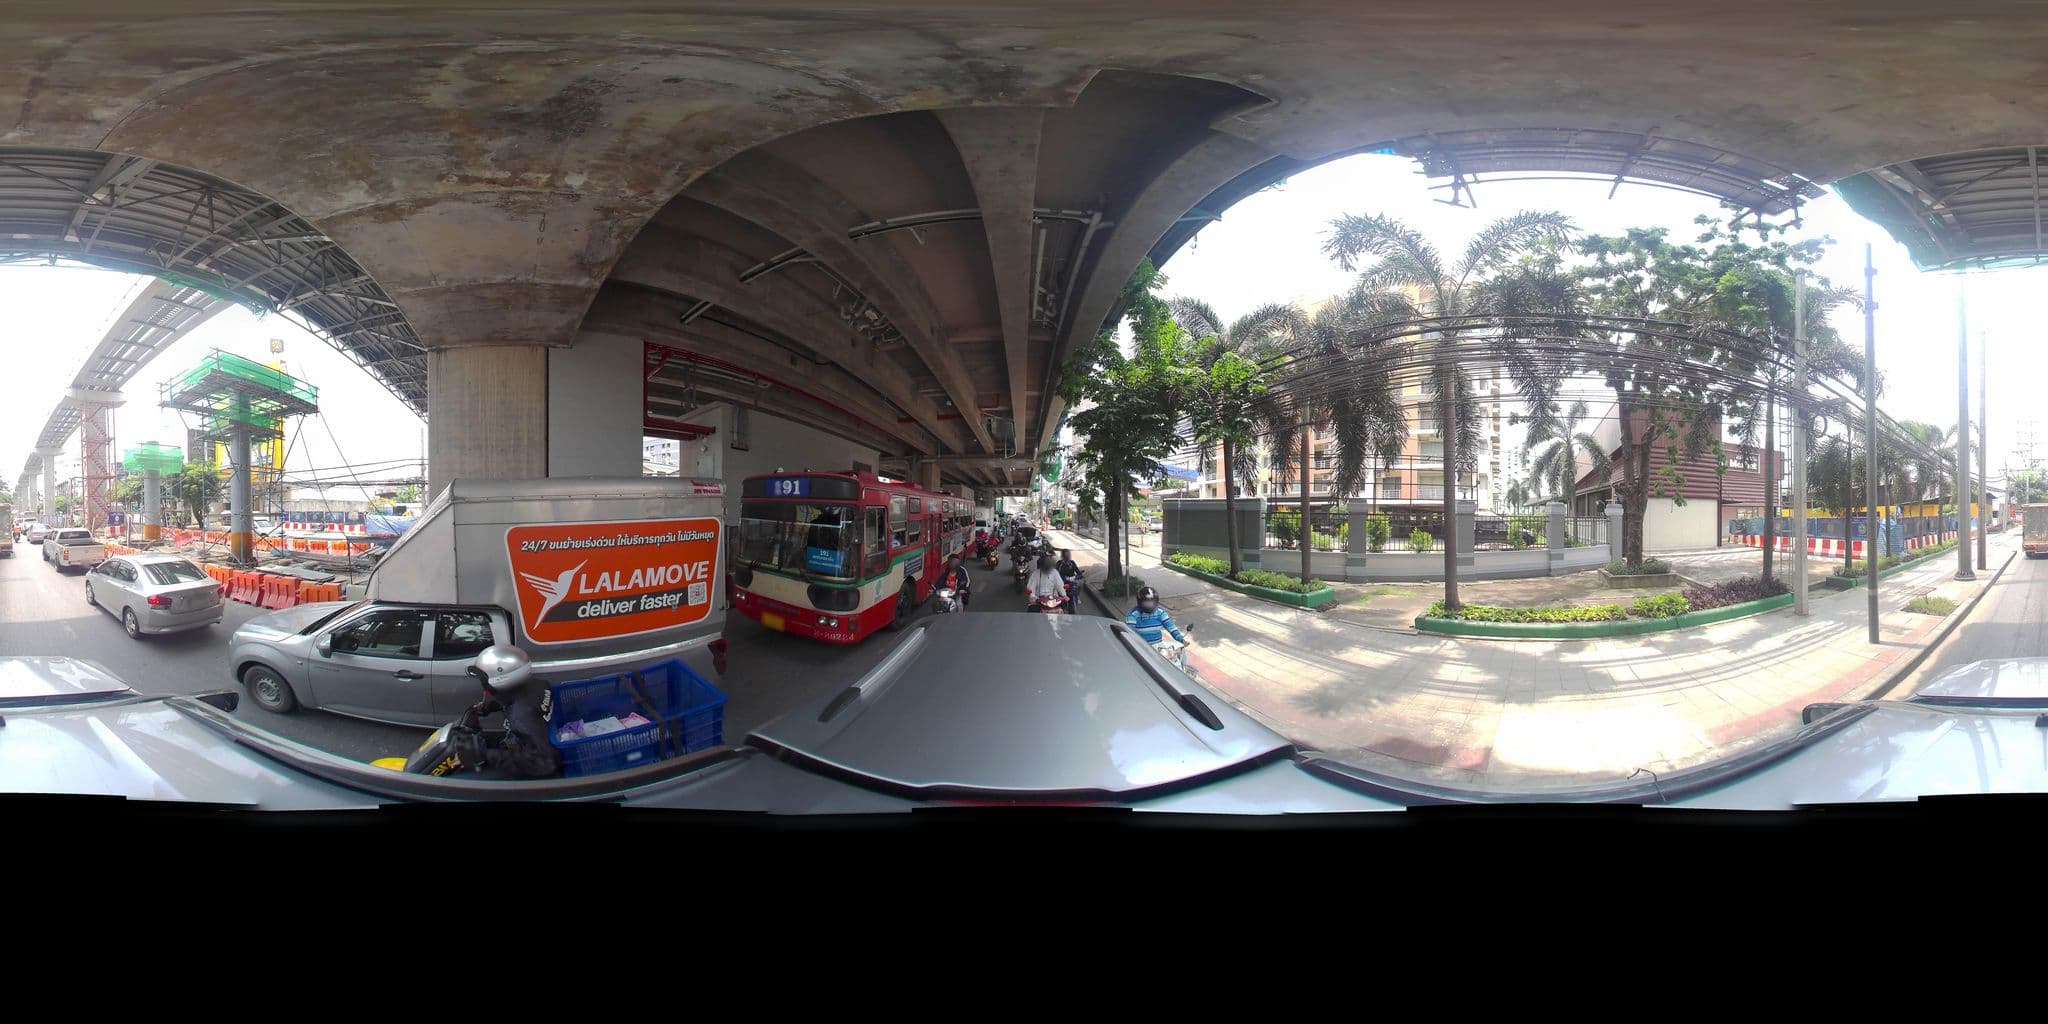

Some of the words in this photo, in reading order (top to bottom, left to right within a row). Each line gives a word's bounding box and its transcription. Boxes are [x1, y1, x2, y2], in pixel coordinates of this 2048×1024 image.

[521, 539, 547, 553] 24/7
[549, 536, 615, 550] ขนย้ายเร่งด่วน
[617, 532, 676, 547] ให้บริการทุกวัน
[677, 530, 714, 543] ไม่มีวันหยุด
[579, 561, 710, 594] LALAMOVE
[577, 598, 637, 618] deliver
[640, 591, 683, 611] faster
